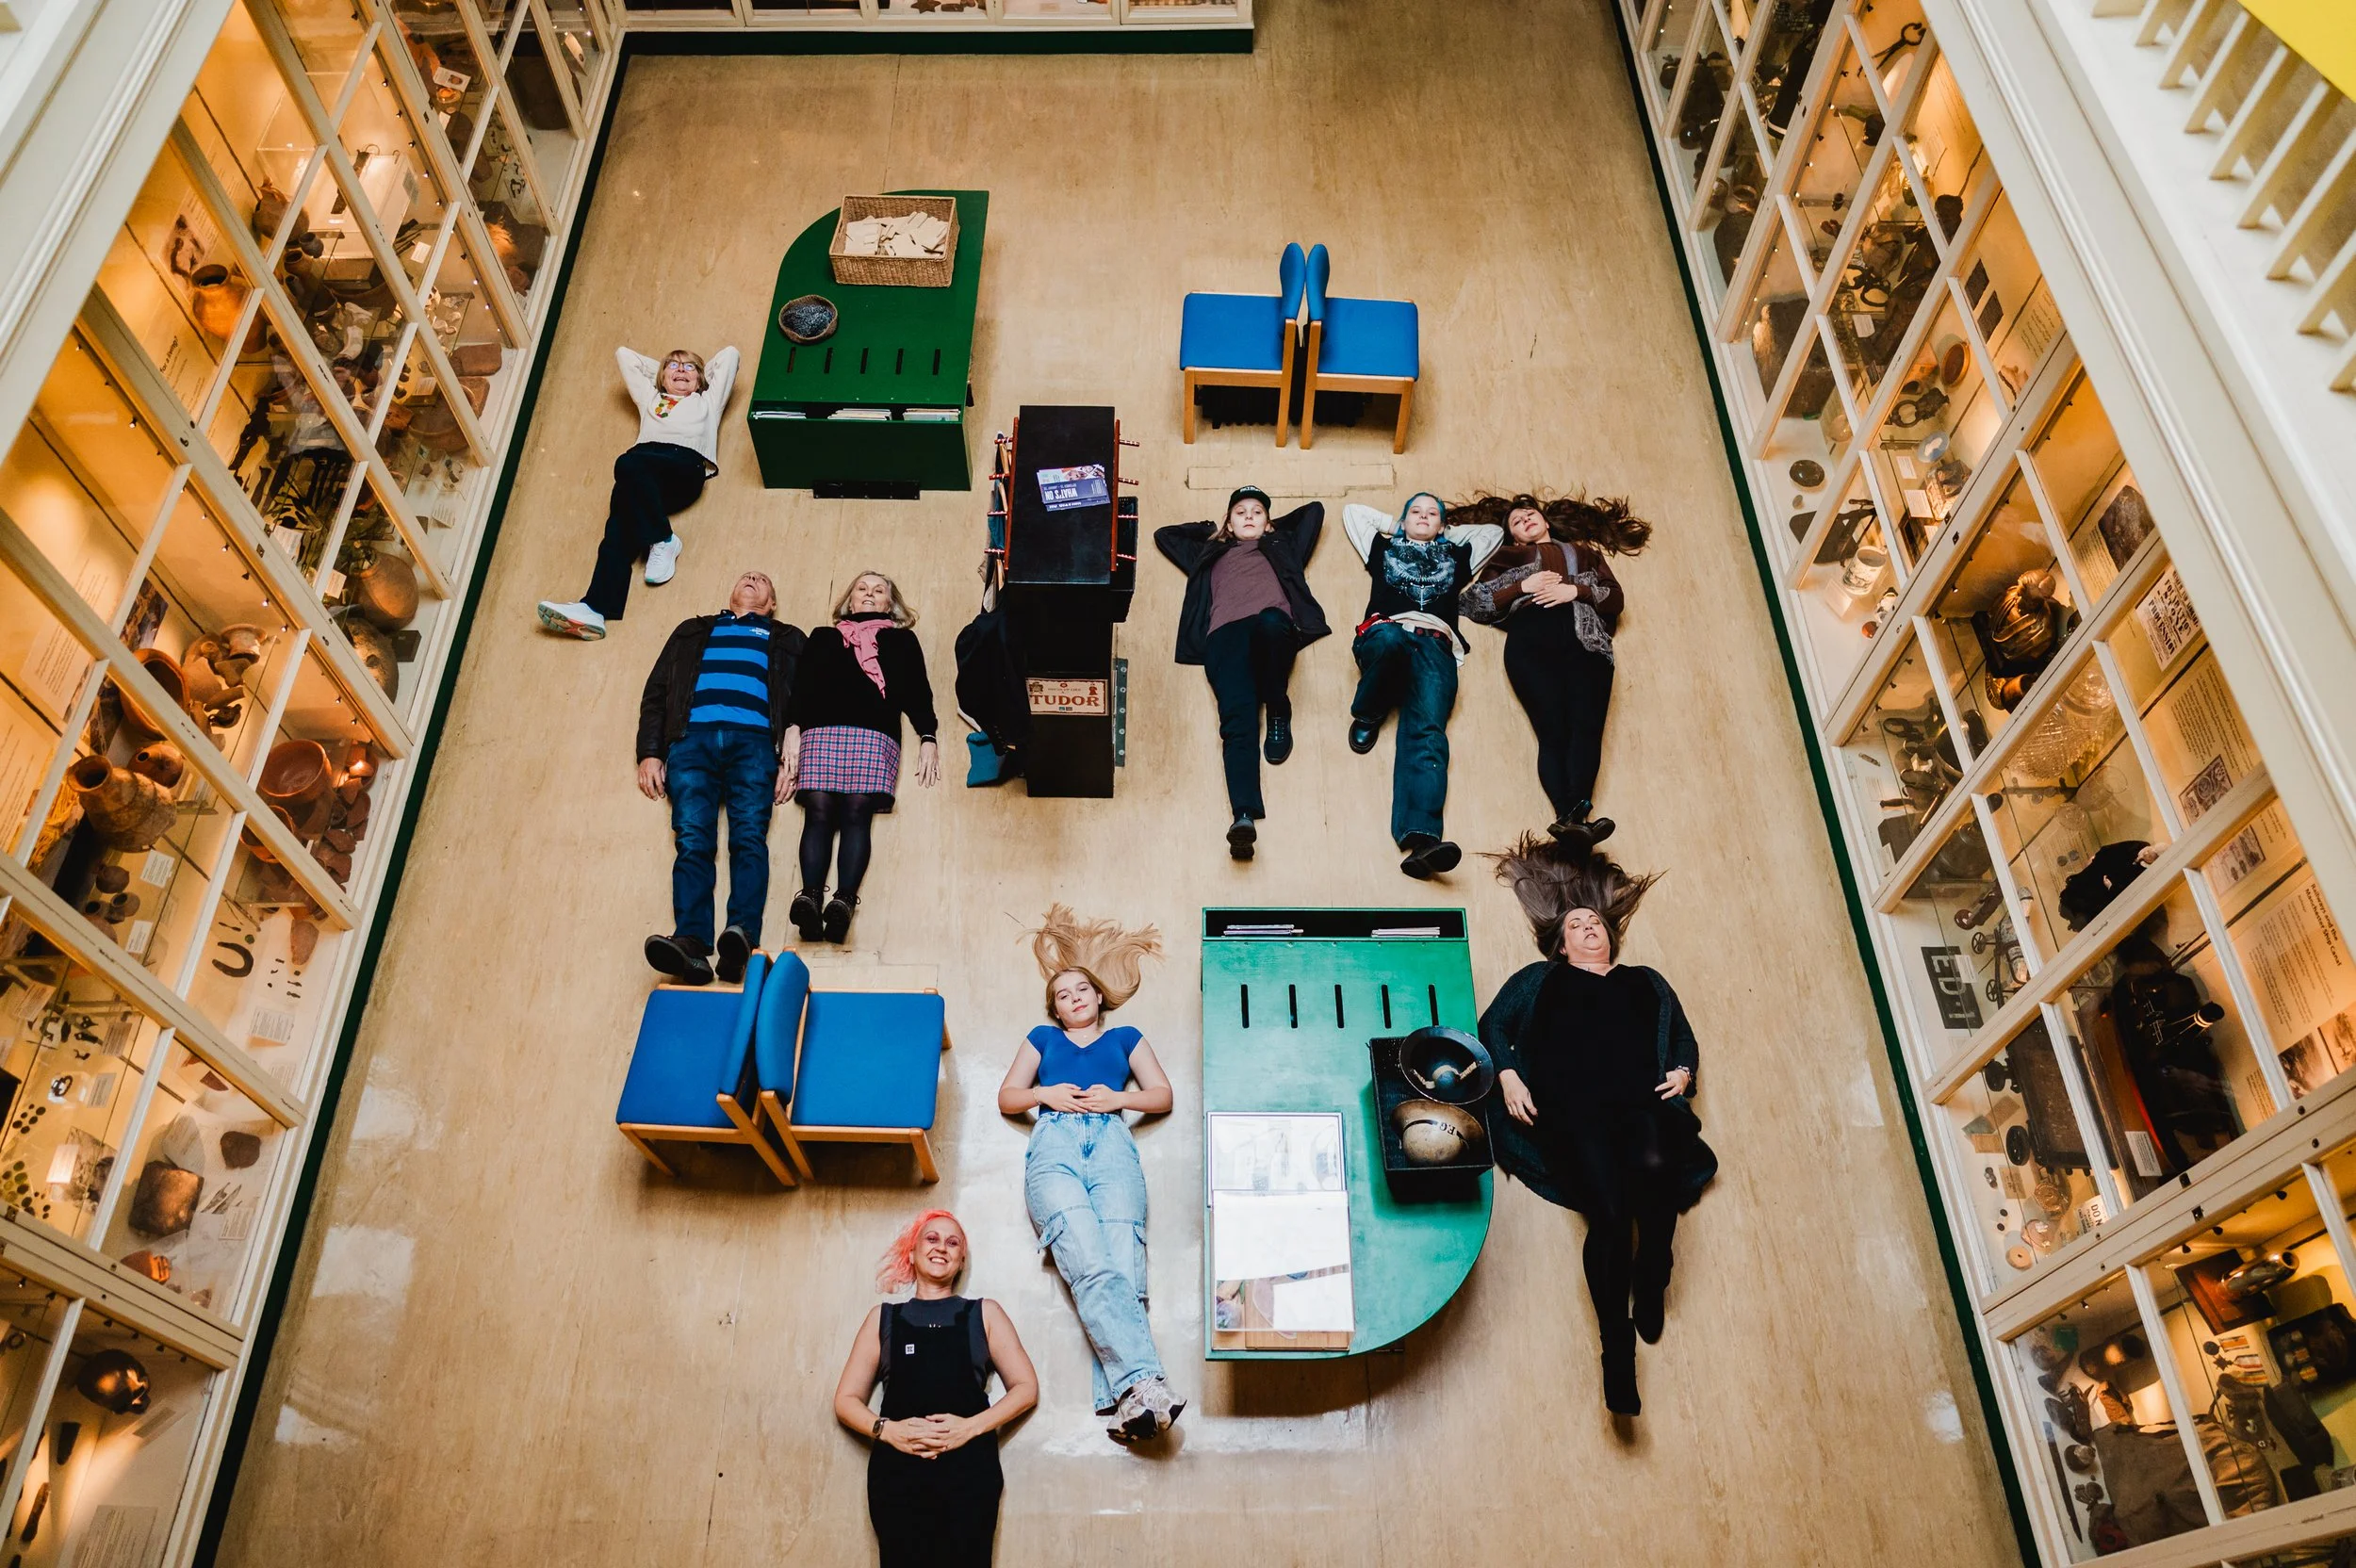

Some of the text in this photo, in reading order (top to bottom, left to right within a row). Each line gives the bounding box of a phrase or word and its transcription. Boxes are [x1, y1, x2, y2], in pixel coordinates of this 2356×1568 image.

[1044, 487, 1078, 500] WHAT'S ON
[1030, 694, 1101, 707] TUDOR
[2311, 883, 2327, 913] Railways
[2325, 914, 2333, 928] and
[2305, 889, 2342, 966] Manchester Ship Canal
[2090, 1203, 2102, 1217] DO
